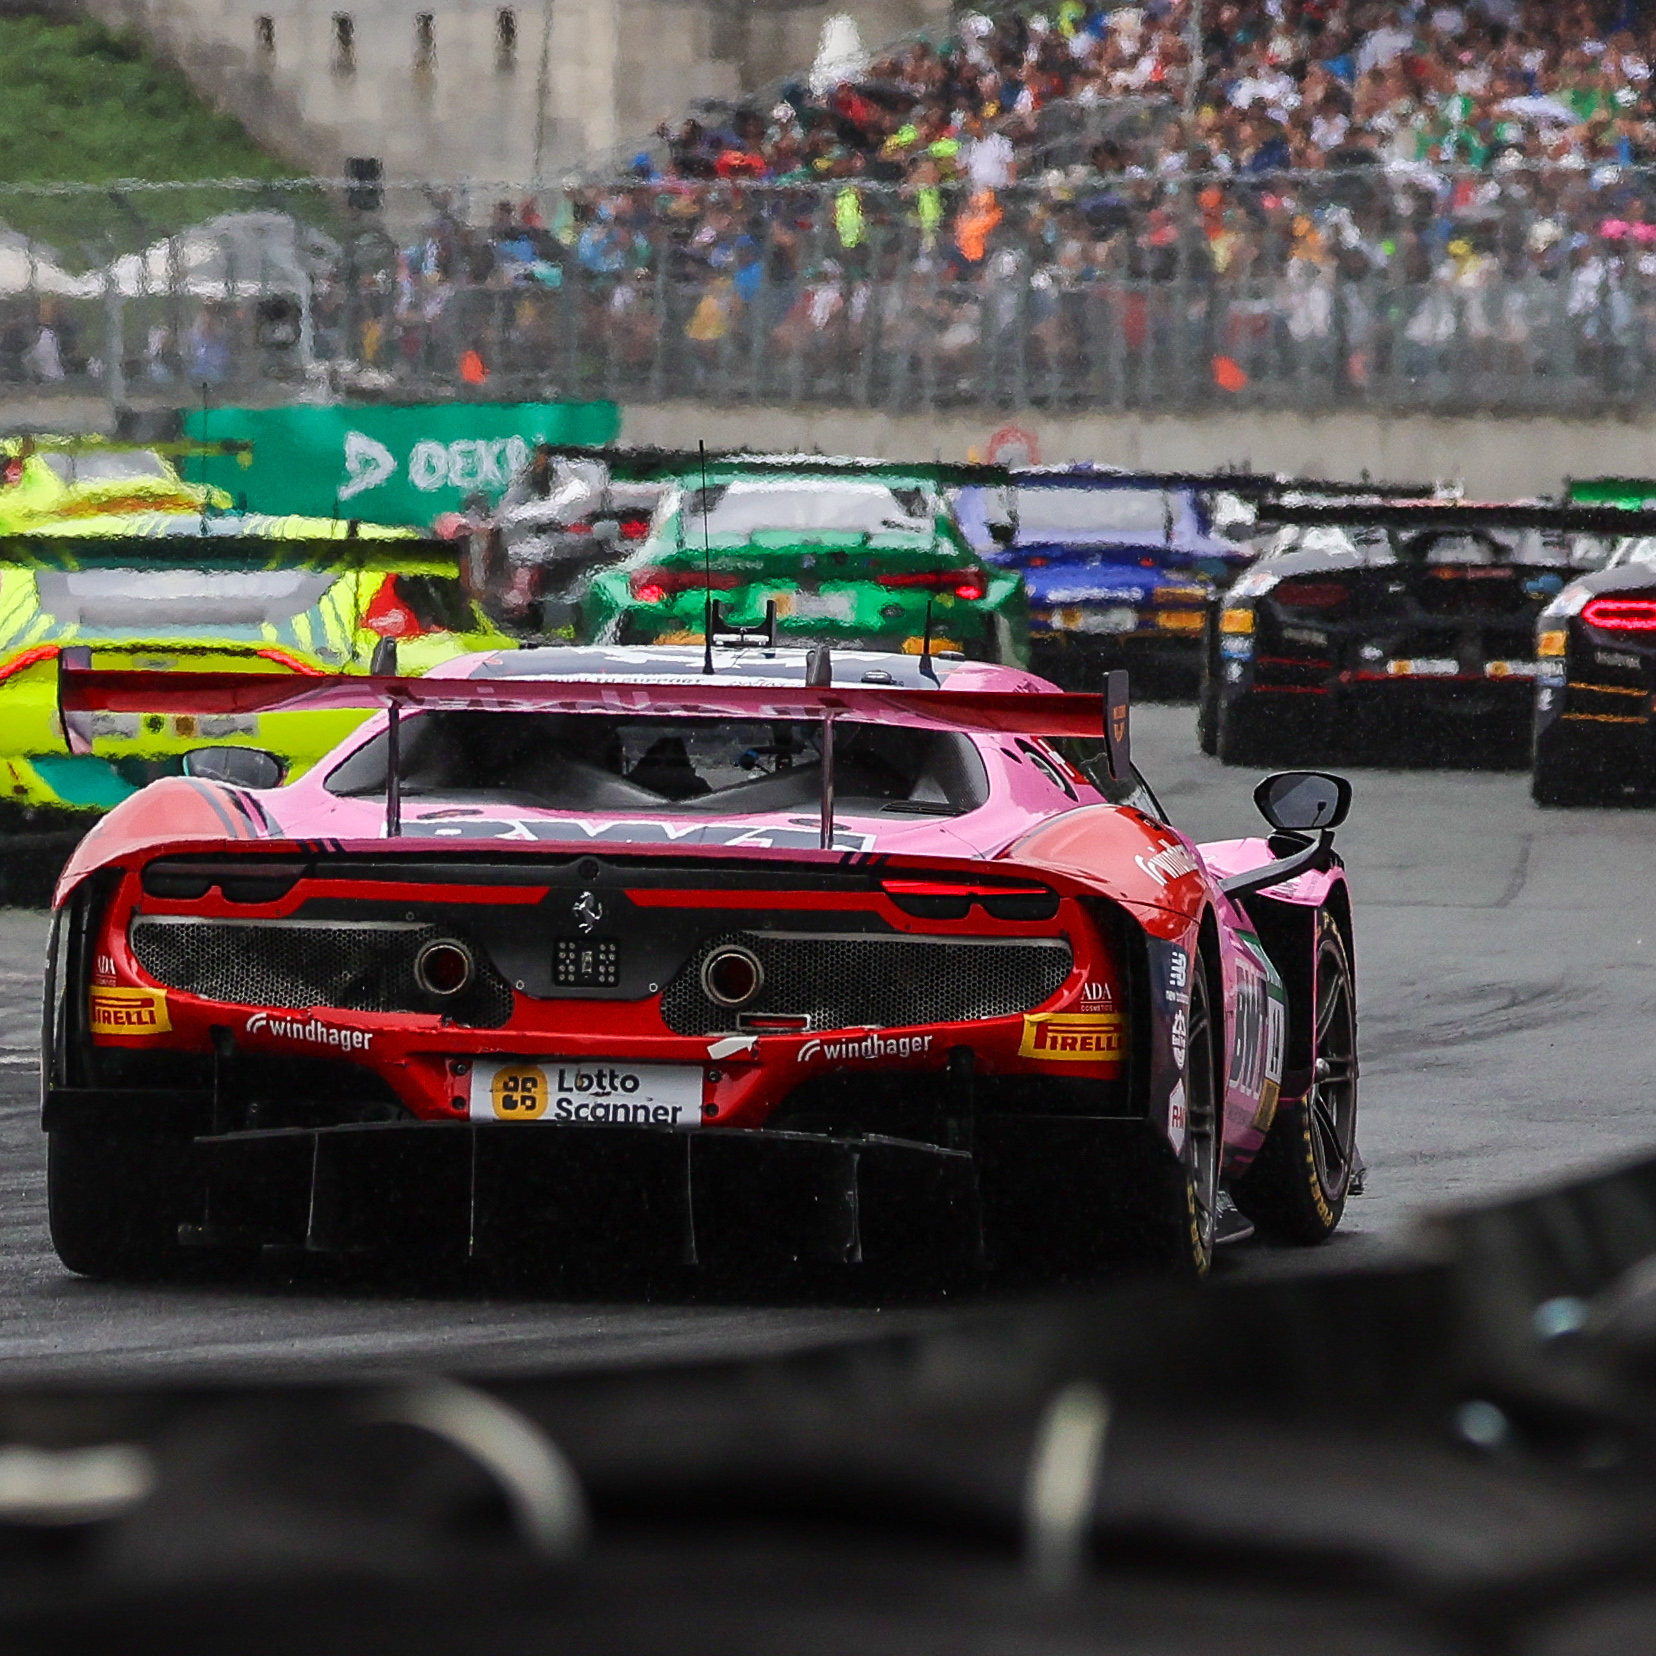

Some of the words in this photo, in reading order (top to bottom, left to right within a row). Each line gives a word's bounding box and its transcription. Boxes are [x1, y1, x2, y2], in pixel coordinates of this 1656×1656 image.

[1081, 982, 1113, 1000] ADA
[269, 1015, 373, 1051] windhager
[823, 1034, 933, 1060] windhager
[557, 1068, 641, 1093] Lotto
[554, 1097, 683, 1124] Scanner
